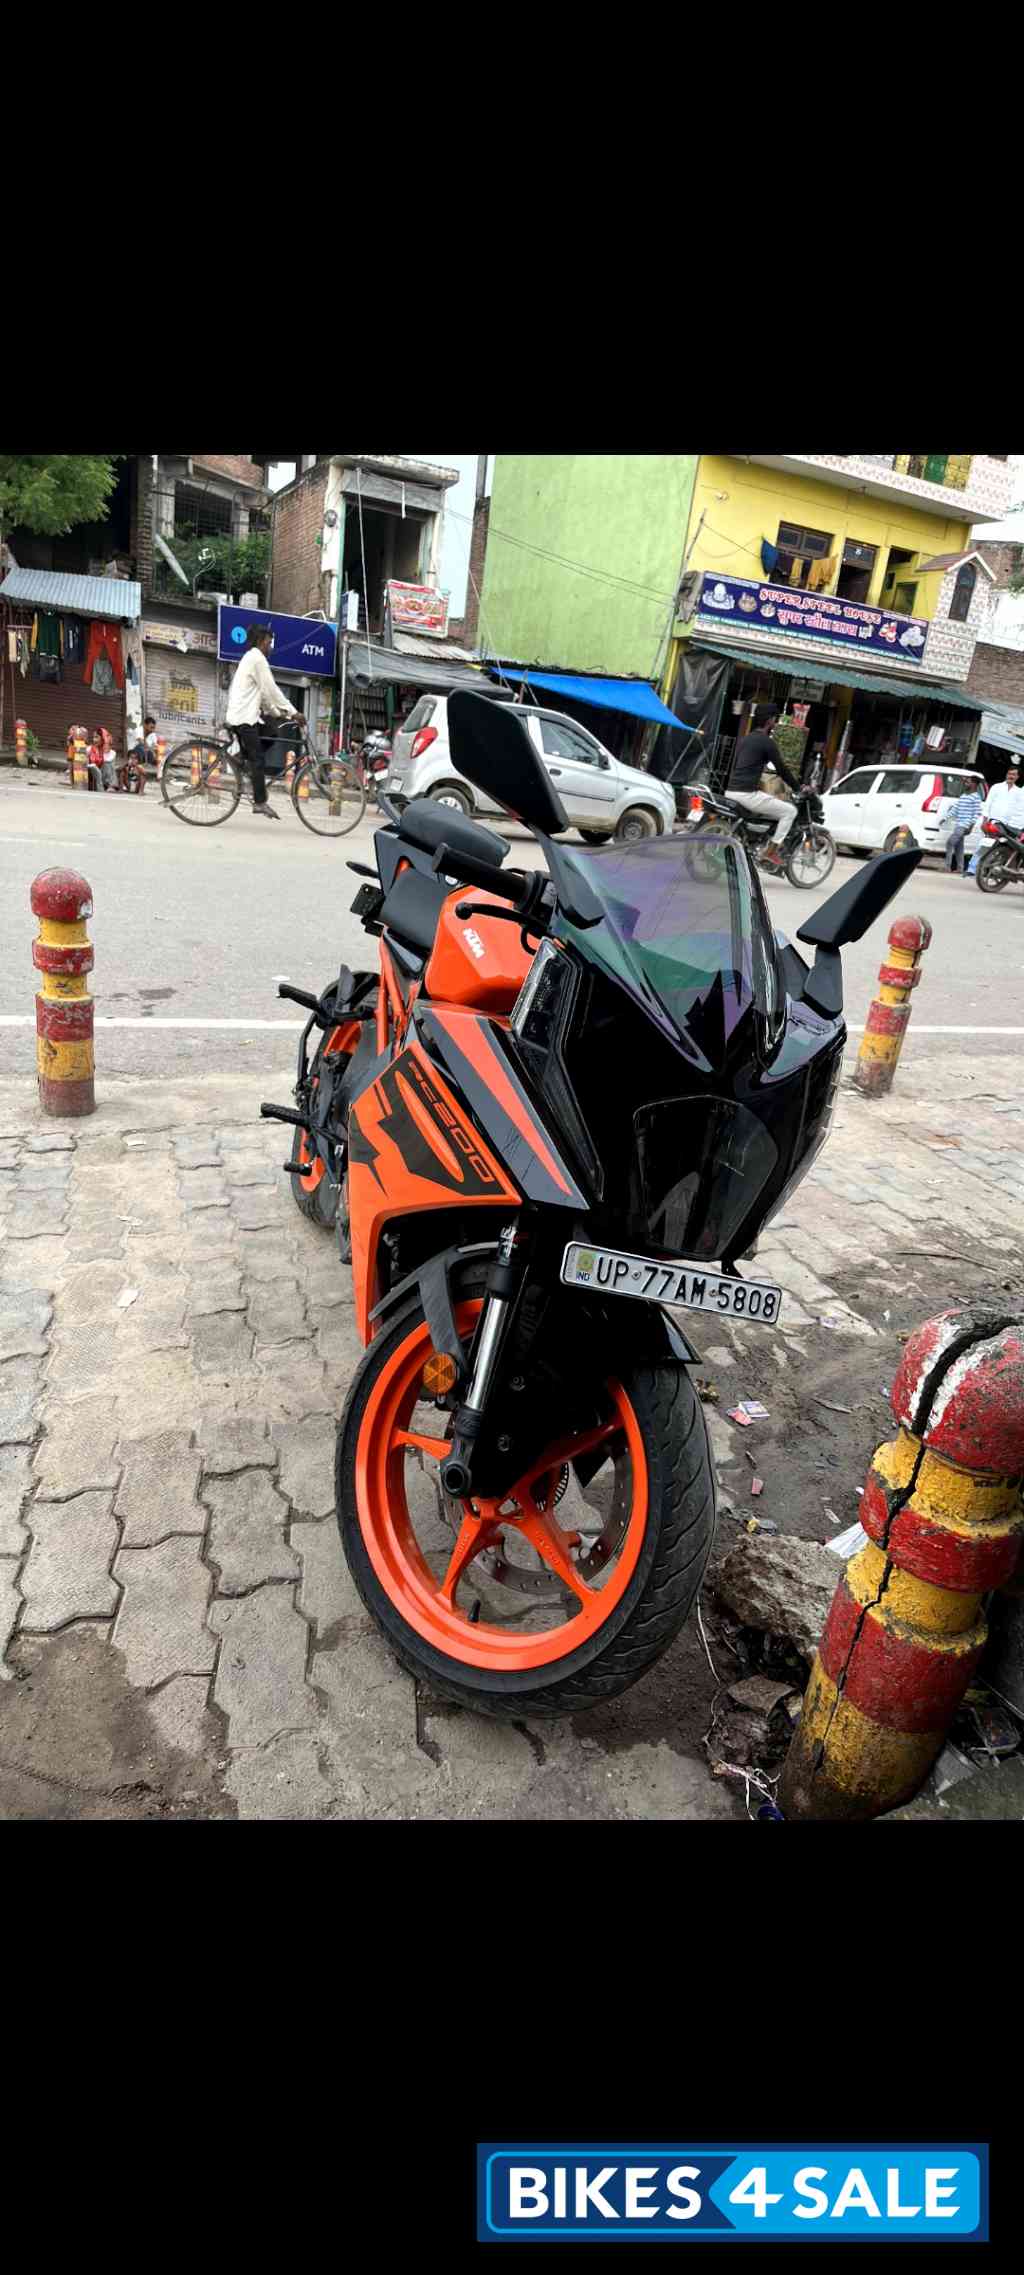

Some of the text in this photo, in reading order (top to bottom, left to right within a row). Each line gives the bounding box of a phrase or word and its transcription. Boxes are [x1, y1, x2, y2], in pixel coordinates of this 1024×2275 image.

[759, 588, 802, 609] SUPER
[802, 597, 842, 616] STEEL
[843, 607, 881, 625] HOUSE
[301, 643, 325, 657] ATM
[462, 927, 486, 959] KTM
[576, 1271, 590, 1281] IND
[596, 1256, 629, 1287] UP
[641, 1266, 707, 1305] 77AM
[716, 1282, 776, 1318] 5808
